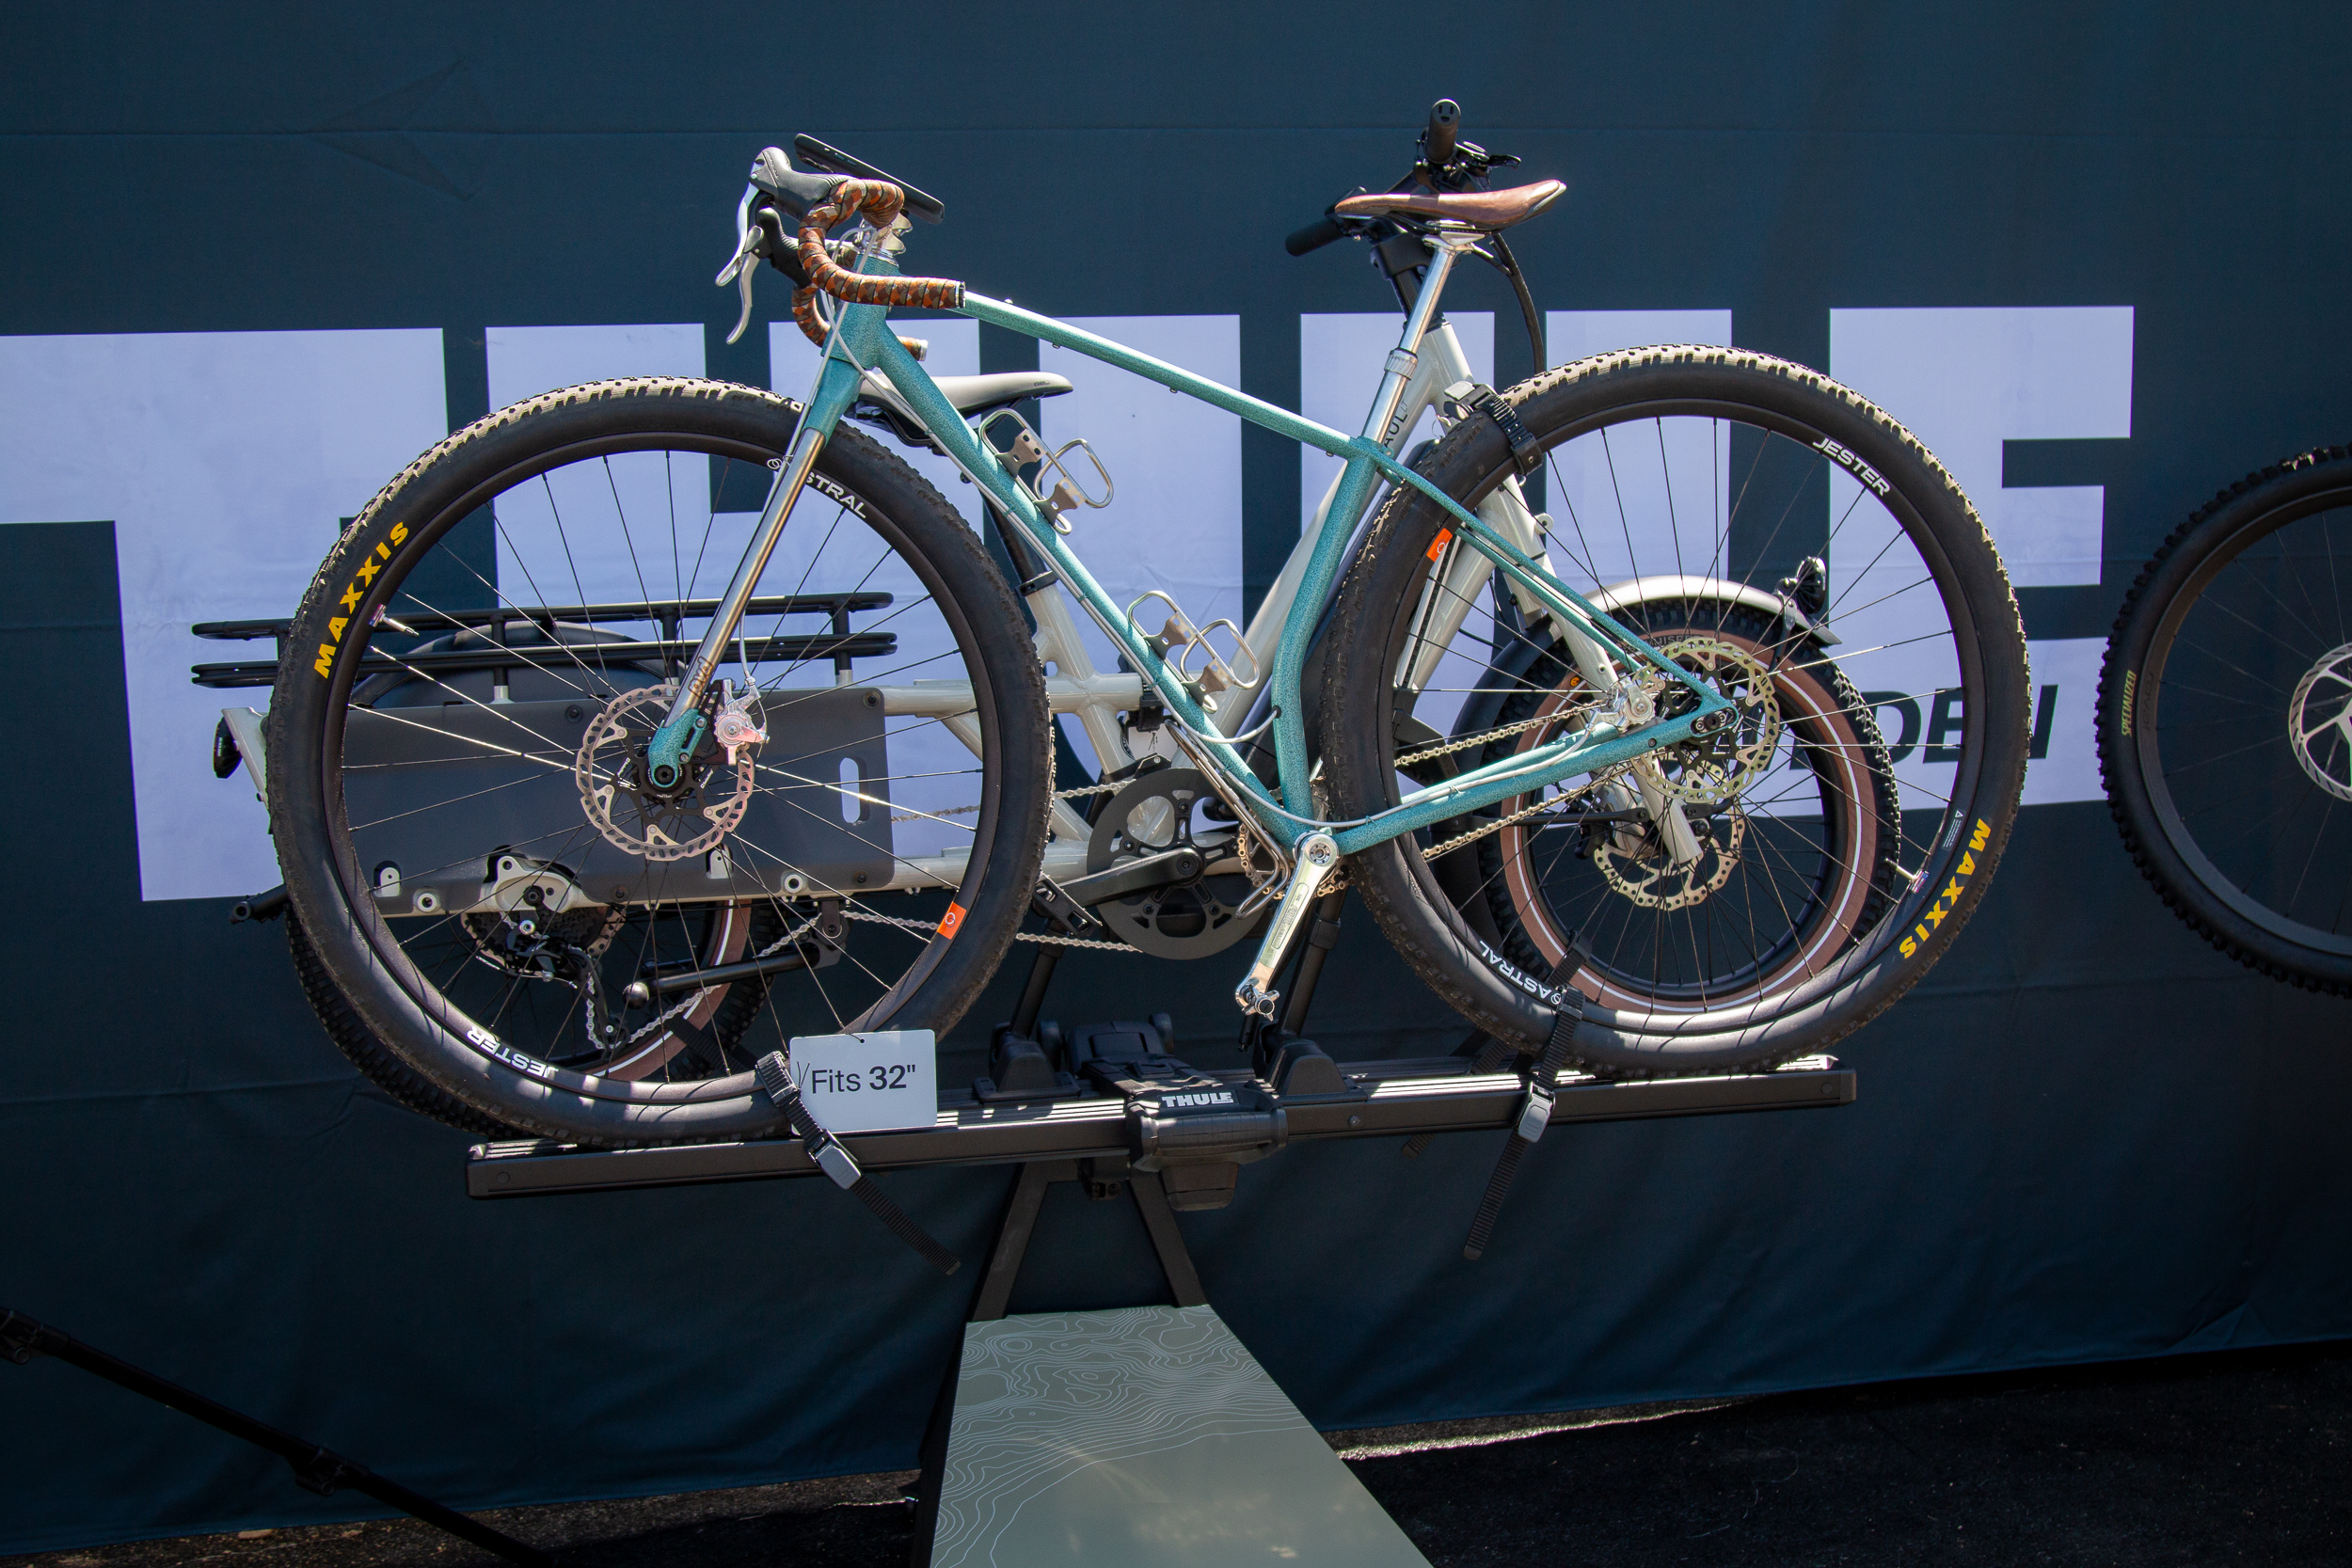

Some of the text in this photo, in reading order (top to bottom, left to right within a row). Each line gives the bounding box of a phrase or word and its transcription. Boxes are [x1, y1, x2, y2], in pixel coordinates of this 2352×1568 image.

[1383, 414, 1408, 448] AUL
[805, 471, 866, 519] STRAL
[1812, 437, 1891, 497] JESTER
[313, 521, 409, 679] MAXXIS
[2121, 669, 2137, 738] SPECIALIZED
[1899, 817, 1992, 959] MAXXIS
[1479, 940, 1553, 1000] ASTRAL
[466, 1025, 560, 1080] JESTER
[811, 1064, 916, 1094] Fits 32"
[1161, 1091, 1234, 1108] THULE
